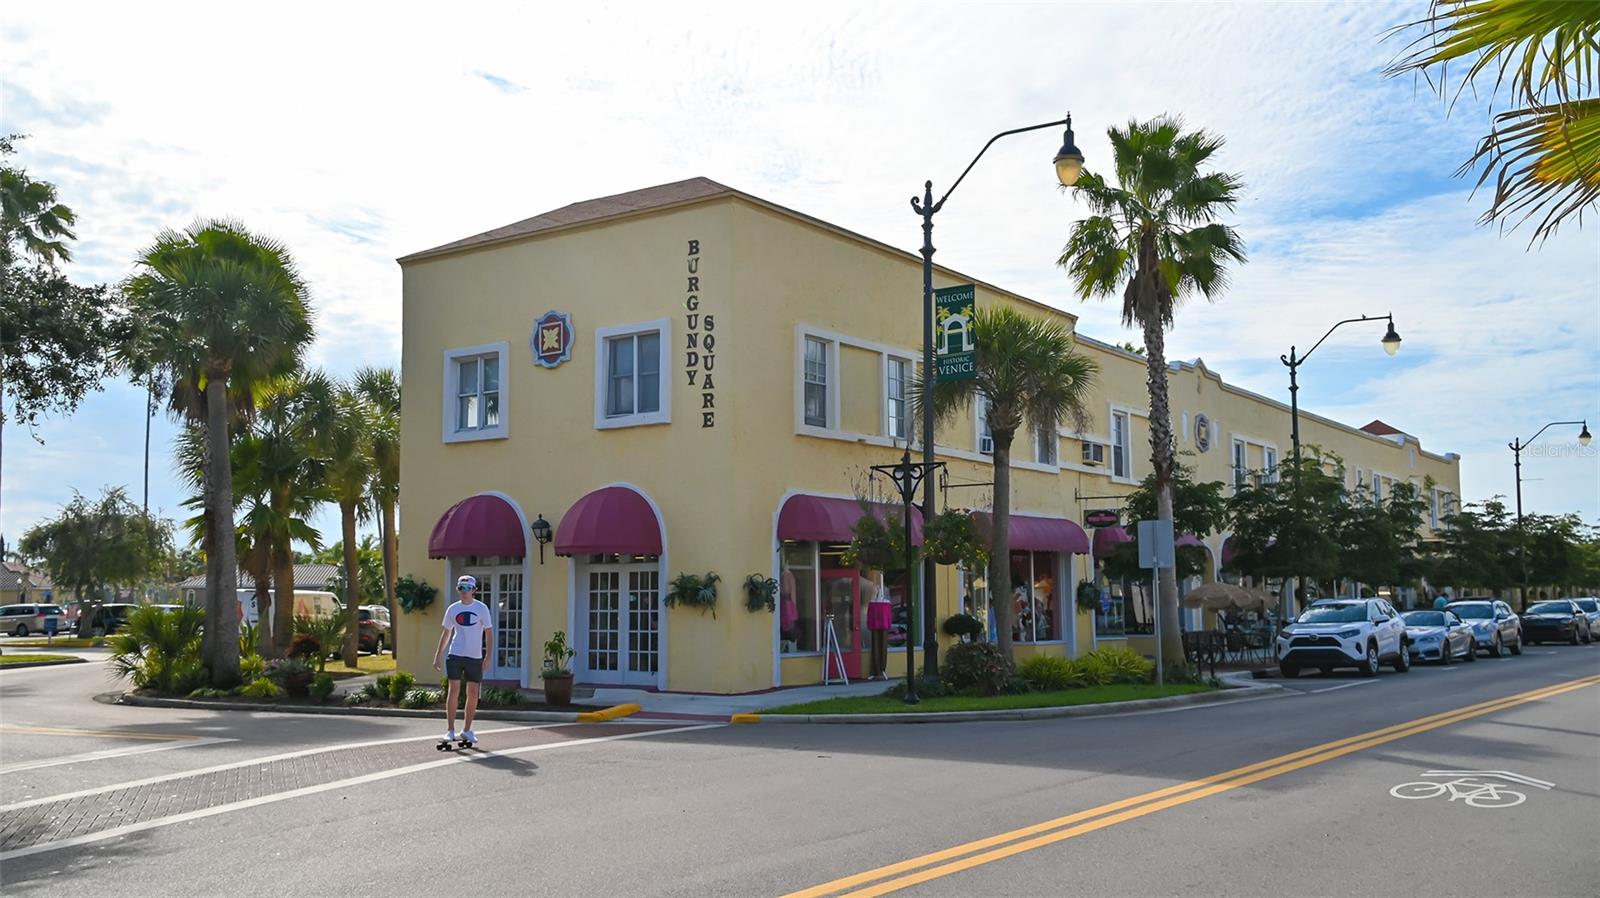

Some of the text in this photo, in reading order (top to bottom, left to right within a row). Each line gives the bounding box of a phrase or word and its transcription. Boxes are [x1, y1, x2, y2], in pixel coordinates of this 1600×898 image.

[936, 291, 974, 303] WELCOME
[686, 239, 700, 386] BURGUNDY
[943, 355, 970, 365] HISTORIC
[702, 314, 715, 428] SQUARE
[939, 362, 974, 375] VENICE
